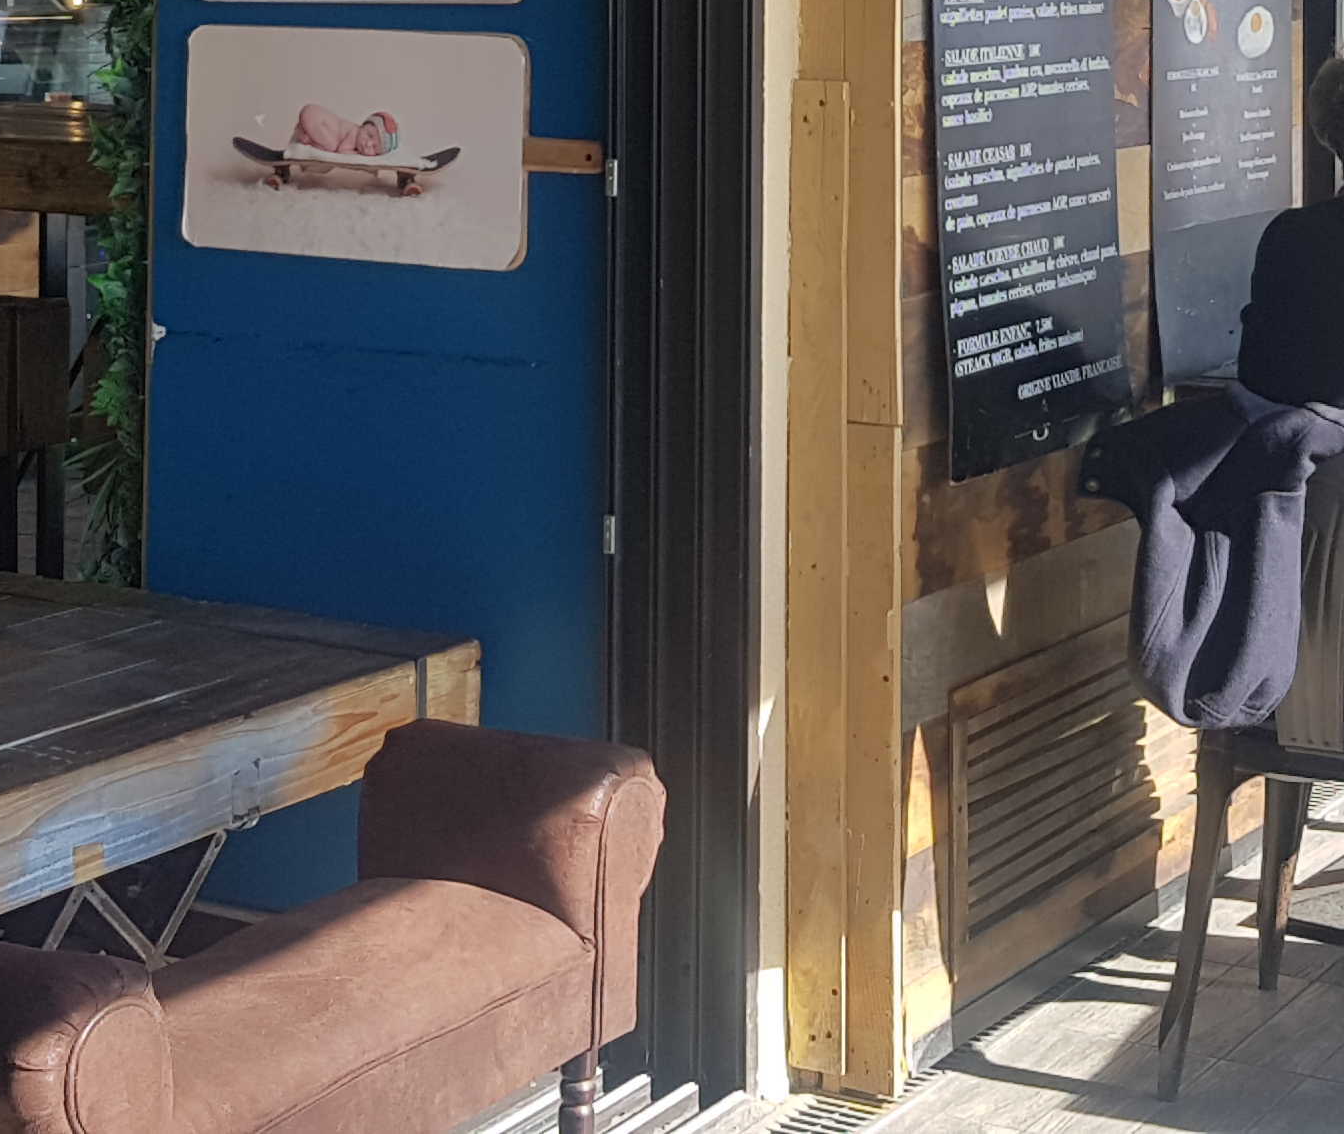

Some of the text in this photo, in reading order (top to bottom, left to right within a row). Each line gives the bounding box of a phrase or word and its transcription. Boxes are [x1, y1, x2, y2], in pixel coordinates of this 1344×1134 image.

[948, 149, 982, 170] SALADE
[952, 253, 986, 274] SALADE
[1021, 238, 1049, 259] CHAUD
[957, 330, 999, 358] FORMULE
[955, 352, 992, 378] (STEACK
[1017, 354, 1122, 401] ORIGINE VIANDE FRANCAISE
